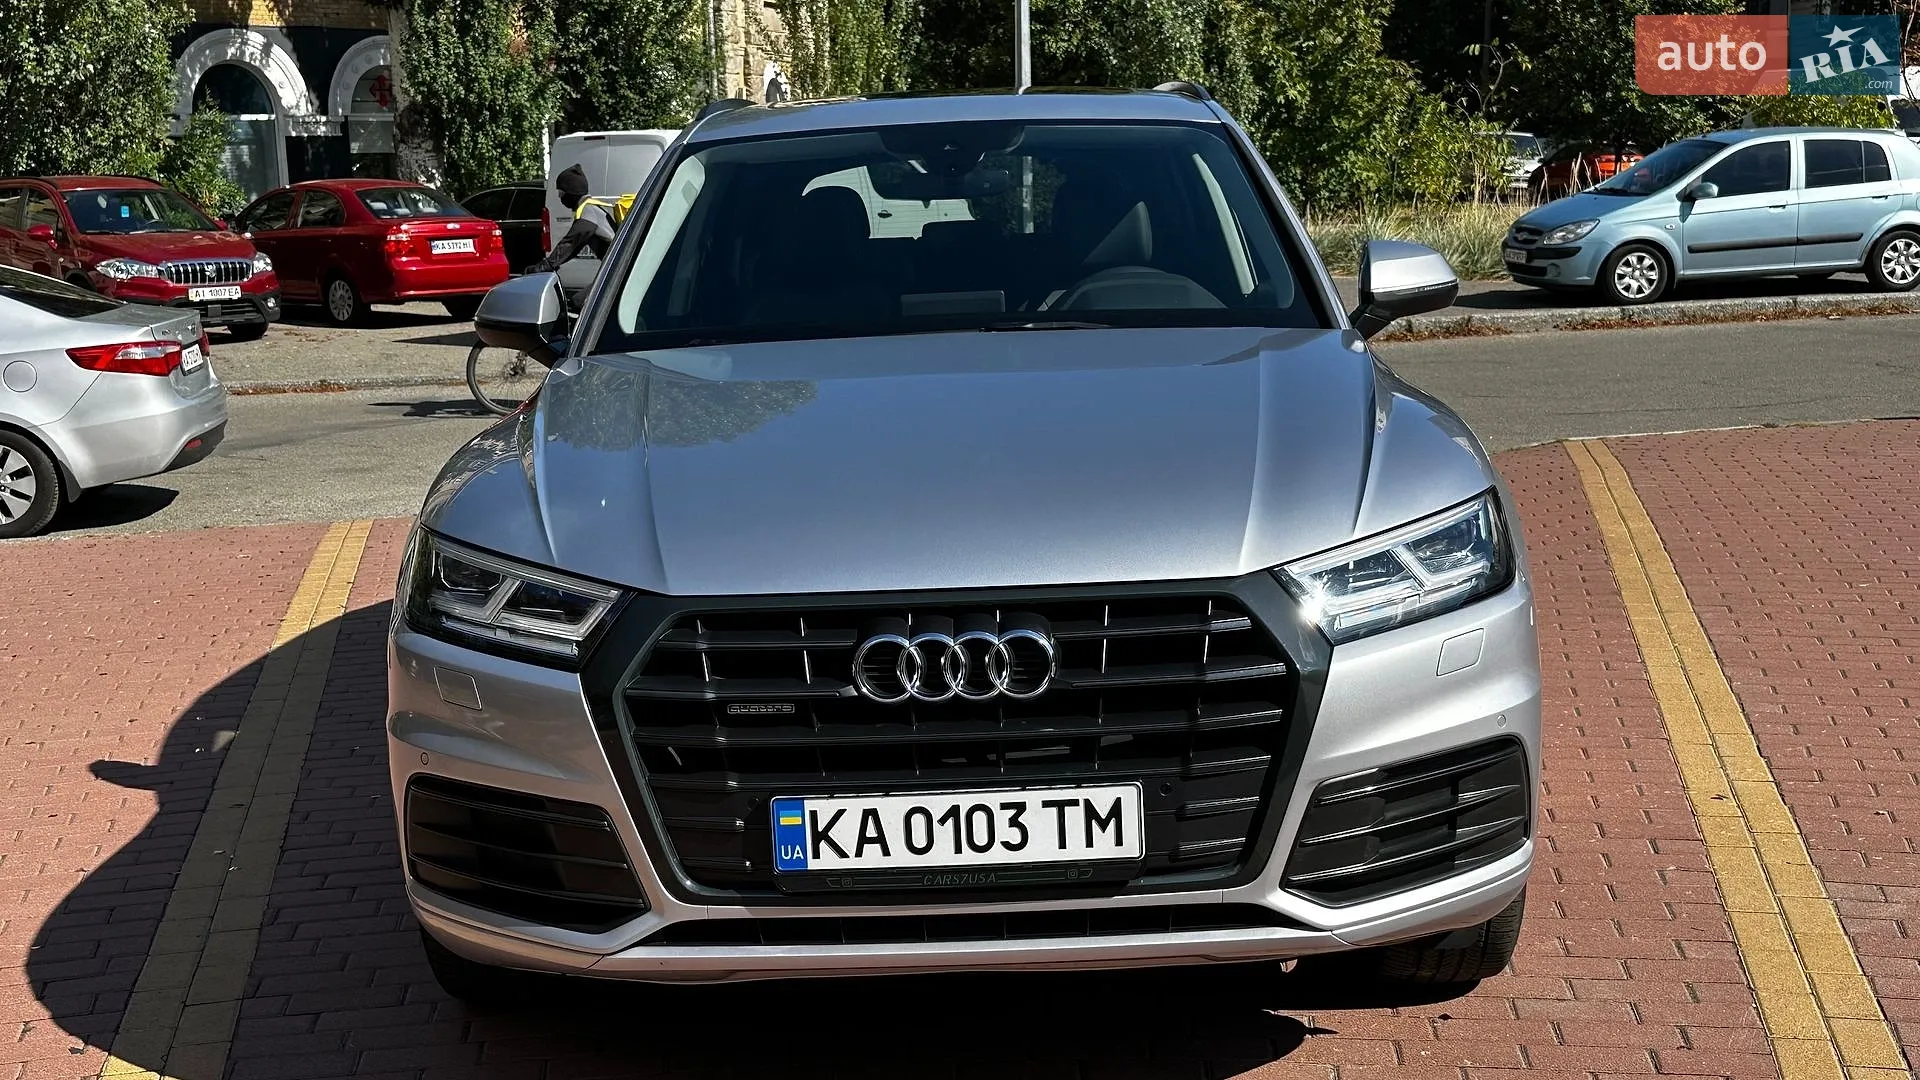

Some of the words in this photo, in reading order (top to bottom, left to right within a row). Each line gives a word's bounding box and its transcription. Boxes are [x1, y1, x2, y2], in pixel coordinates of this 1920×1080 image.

[195, 289, 206, 298] AI
[228, 287, 240, 297] EA
[808, 807, 891, 860] KA
[903, 801, 1029, 856] 0103
[1041, 796, 1124, 850] TM
[781, 845, 804, 860] UA
